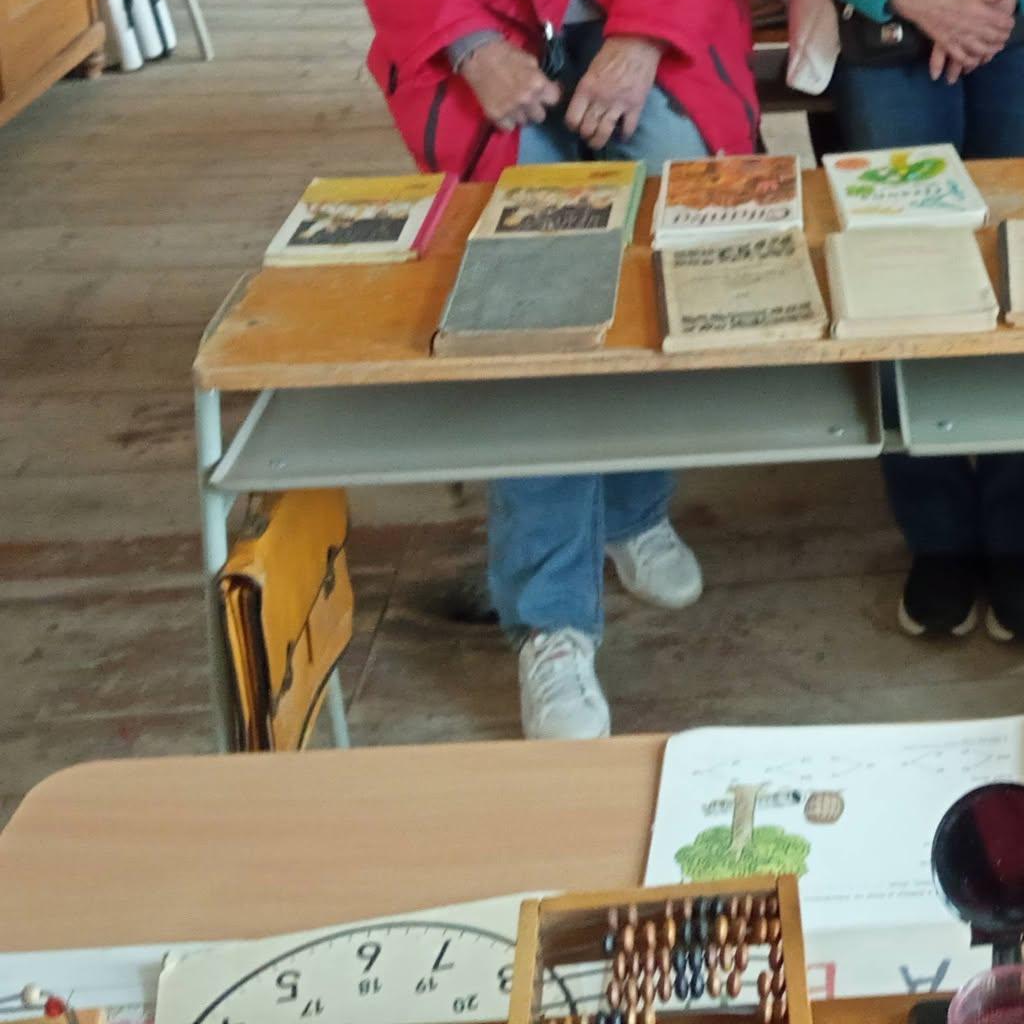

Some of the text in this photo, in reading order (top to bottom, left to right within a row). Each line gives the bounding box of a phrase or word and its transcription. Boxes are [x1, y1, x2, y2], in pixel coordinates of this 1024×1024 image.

[431, 938, 455, 973] 7
[276, 969, 301, 1004] 5
[358, 977, 383, 996] 18
[415, 976, 439, 993] 19
[300, 997, 325, 1018] 17
[453, 993, 479, 1014] 20
